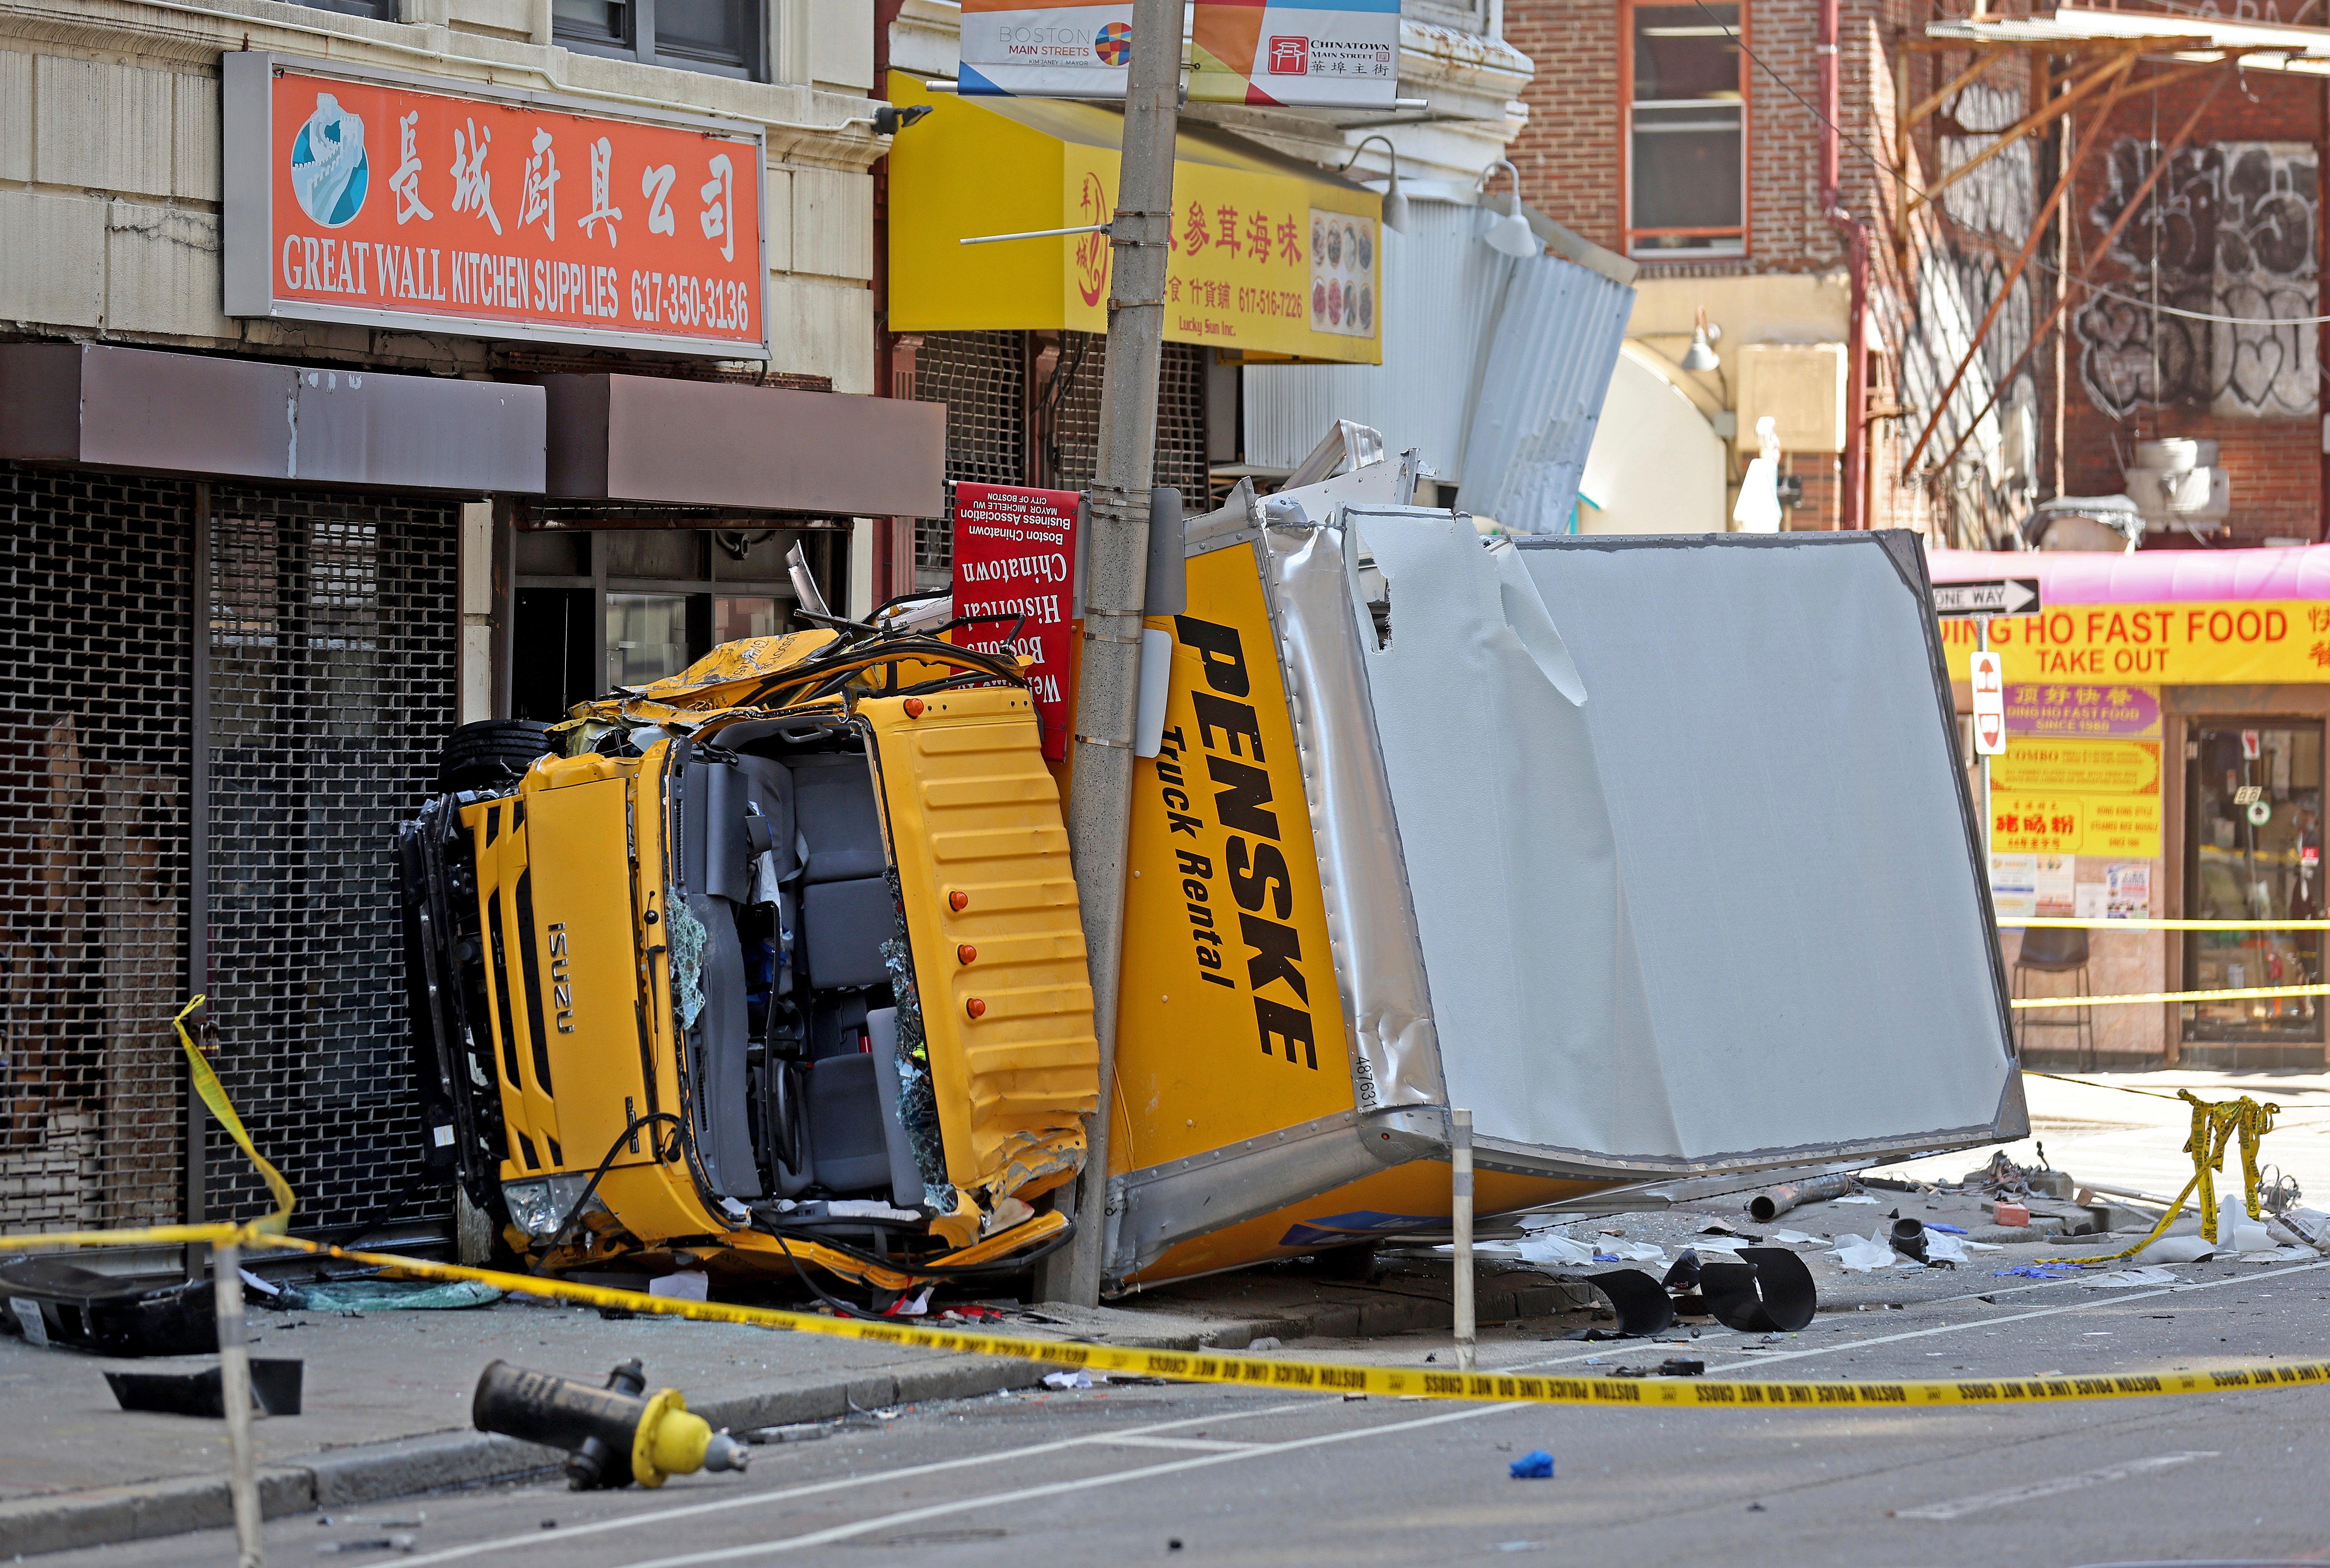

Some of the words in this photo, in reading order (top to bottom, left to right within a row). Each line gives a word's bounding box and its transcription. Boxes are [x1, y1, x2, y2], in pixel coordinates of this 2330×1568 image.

[1000, 26, 1090, 44] BOSTON
[1009, 45, 1038, 55] MAIN
[1041, 46, 1089, 57] STREETS
[1310, 39, 1390, 51] CHINATOWN
[1309, 60, 1390, 76] 華埠主街
[282, 233, 370, 295] GREAT
[375, 242, 446, 302] WALL
[451, 250, 529, 309] KITCHEN
[534, 258, 619, 319] SUPPLIES
[631, 268, 749, 332] 617-350-3136
[1239, 286, 1303, 319] 617-516-7226
[1179, 315, 1203, 336] Lucky
[1205, 318, 1220, 335] Sun
[1222, 321, 1236, 337] Inc.
[973, 501, 986, 510] WU
[987, 492, 1017, 503] BOSTON
[1019, 495, 1029, 504] OF
[1031, 495, 1047, 505] CITY
[988, 502, 1027, 513] MICHELLE
[1030, 506, 1058, 516] MAYOR
[960, 509, 1021, 526] Association
[1023, 516, 1071, 531] Business
[968, 525, 1024, 542] Chinatown
[1026, 530, 1064, 545] Boston
[962, 552, 1067, 584] Chinatown
[1934, 589, 1964, 609] ONE
[1973, 585, 2005, 606] WAY
[2025, 612, 2075, 644] HO
[2087, 610, 2176, 644] FAST
[2188, 609, 2288, 643] FOOD
[769, 633, 801, 660] USDOT
[2036, 648, 2105, 674] TAKE
[2114, 648, 2170, 673] OUT
[2006, 705, 2040, 720] DING
[2041, 706, 2062, 720] HO
[2063, 706, 2099, 720] FAST
[2100, 708, 2140, 721] FOOD
[2035, 718, 2077, 730] SINCE
[2005, 748, 2059, 763] COMBO
[1156, 725, 1204, 841] Truck
[1173, 614, 1319, 1071] PENSKE
[1174, 847, 1236, 990] Rental
[547, 921, 575, 1034] ISUZU
[1355, 1055, 1378, 1108] 487631
[2209, 1369, 2250, 1387] CROSS
[2250, 1366, 2276, 1384] NOT
[2277, 1365, 2295, 1381] DO
[2294, 1363, 2323, 1381] LINE
[1423, 1373, 1463, 1394] CROSS
[1470, 1375, 1493, 1396] NOT
[1499, 1376, 1515, 1397] DO
[1519, 1378, 1544, 1398] LINE
[1549, 1379, 1589, 1399] POLICE
[1593, 1381, 1641, 1402] BOSTON
[1695, 1382, 1735, 1402] CROSS
[1738, 1383, 1764, 1402] NOT
[1859, 1383, 1907, 1402] BOSTON
[1957, 1381, 1998, 1400] CROSS
[2001, 1381, 2025, 1399] NOT
[2028, 1380, 2046, 1397] DO
[2046, 1379, 2073, 1397] LINE
[2074, 1377, 2113, 1396] POLICE
[2115, 1375, 2163, 1393] BOSTON
[1767, 1384, 1785, 1402] DO
[1789, 1384, 1813, 1403] LINE
[1815, 1384, 1857, 1403] POLICE
